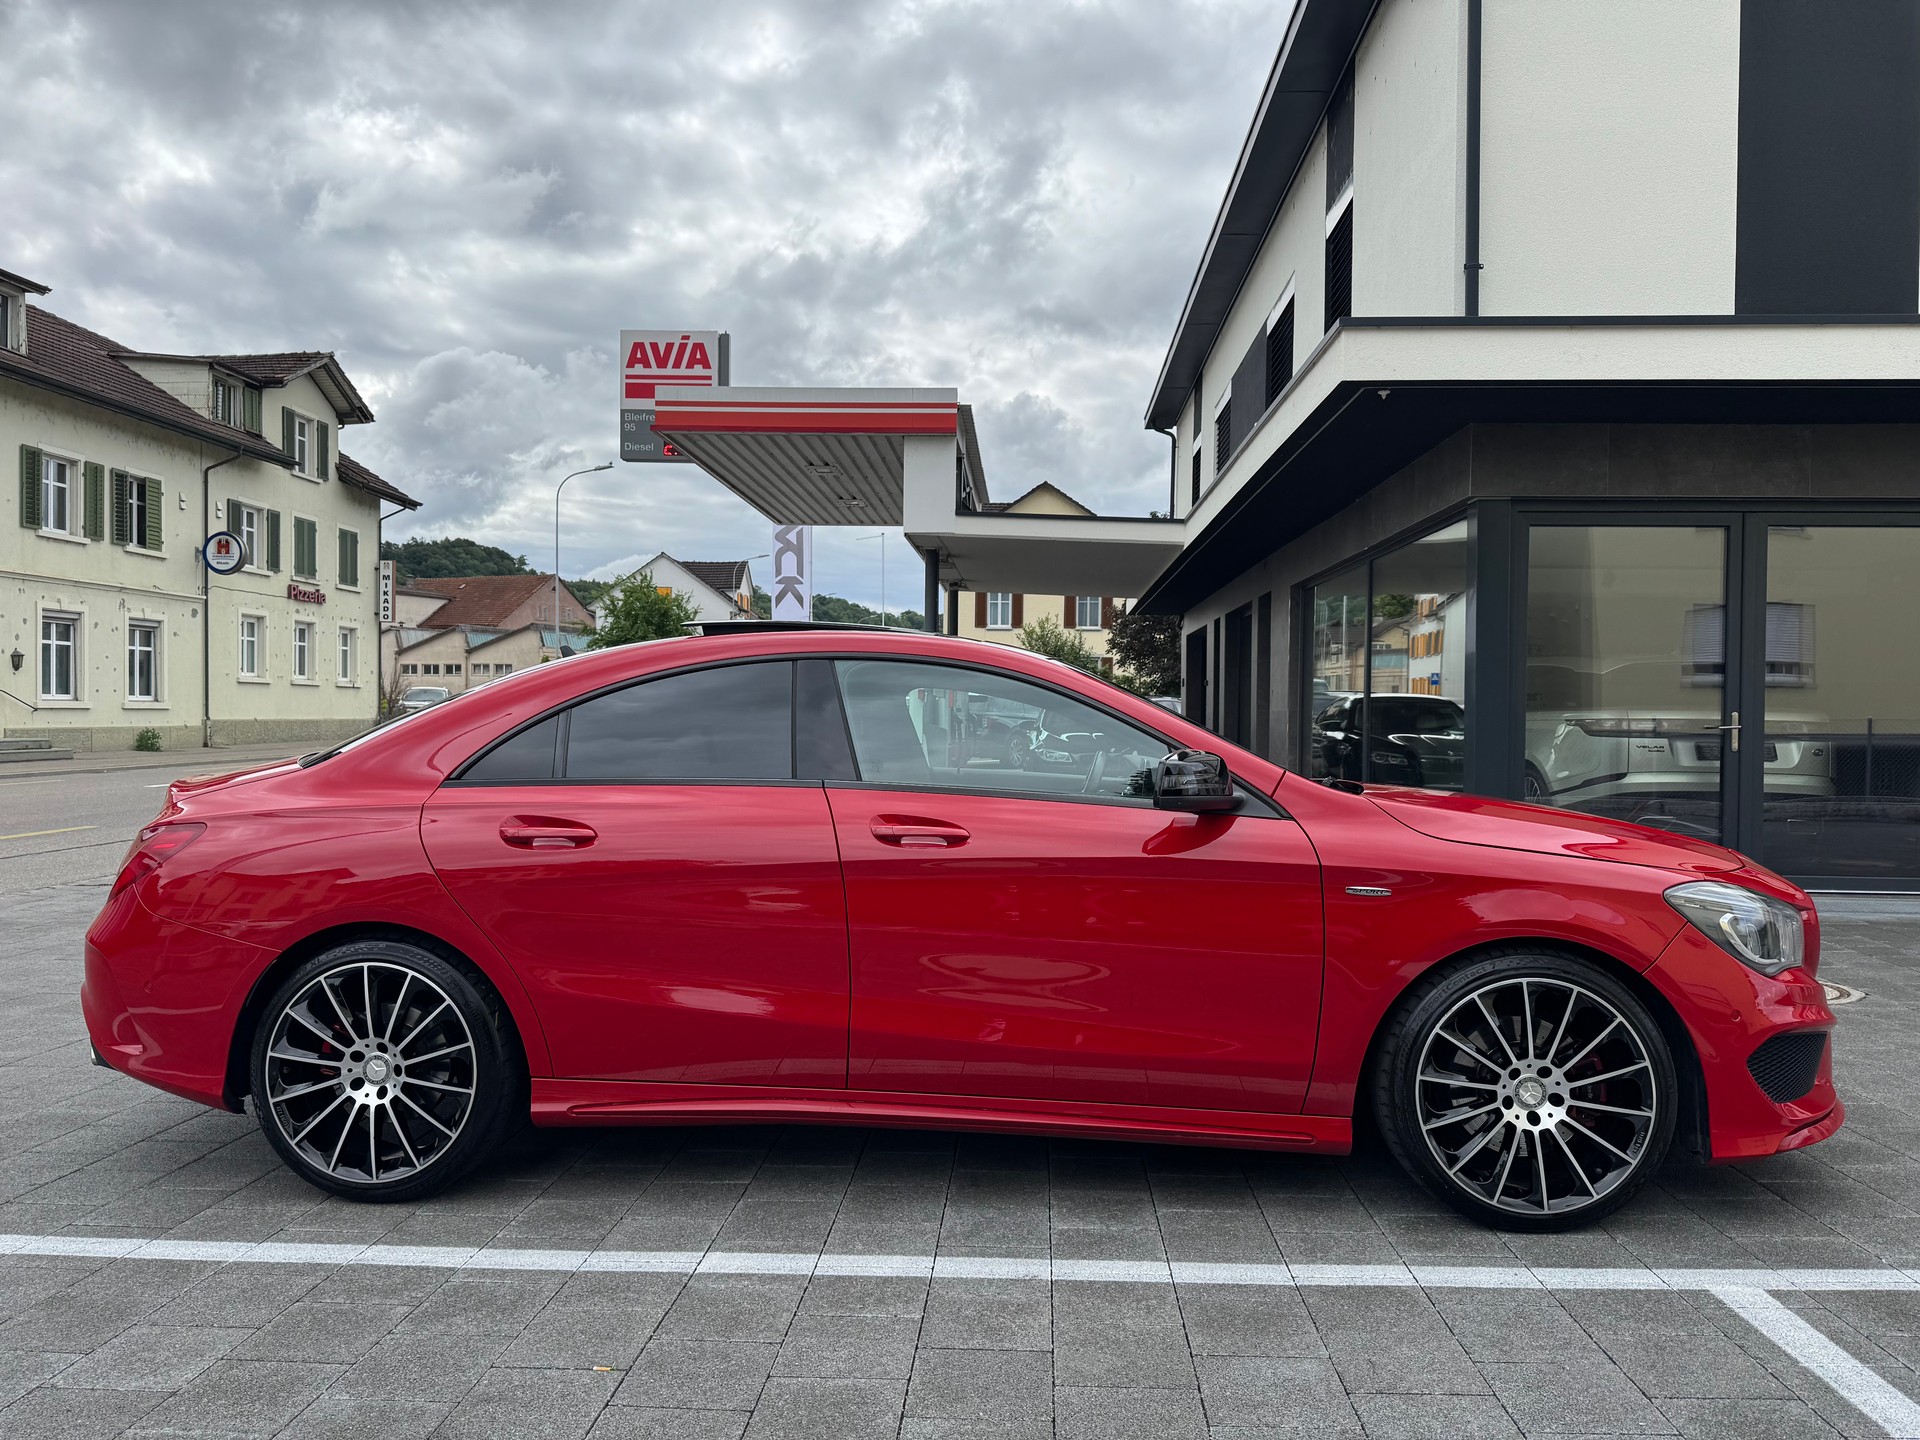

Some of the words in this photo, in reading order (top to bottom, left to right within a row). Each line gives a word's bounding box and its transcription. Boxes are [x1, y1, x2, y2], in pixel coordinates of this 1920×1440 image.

[624, 423, 636, 431] 95
[624, 442, 654, 451] Diesel
[289, 584, 327, 605] Pizzeria
[382, 574, 391, 620] MIKADO
[1423, 966, 1487, 1014] SportContact
